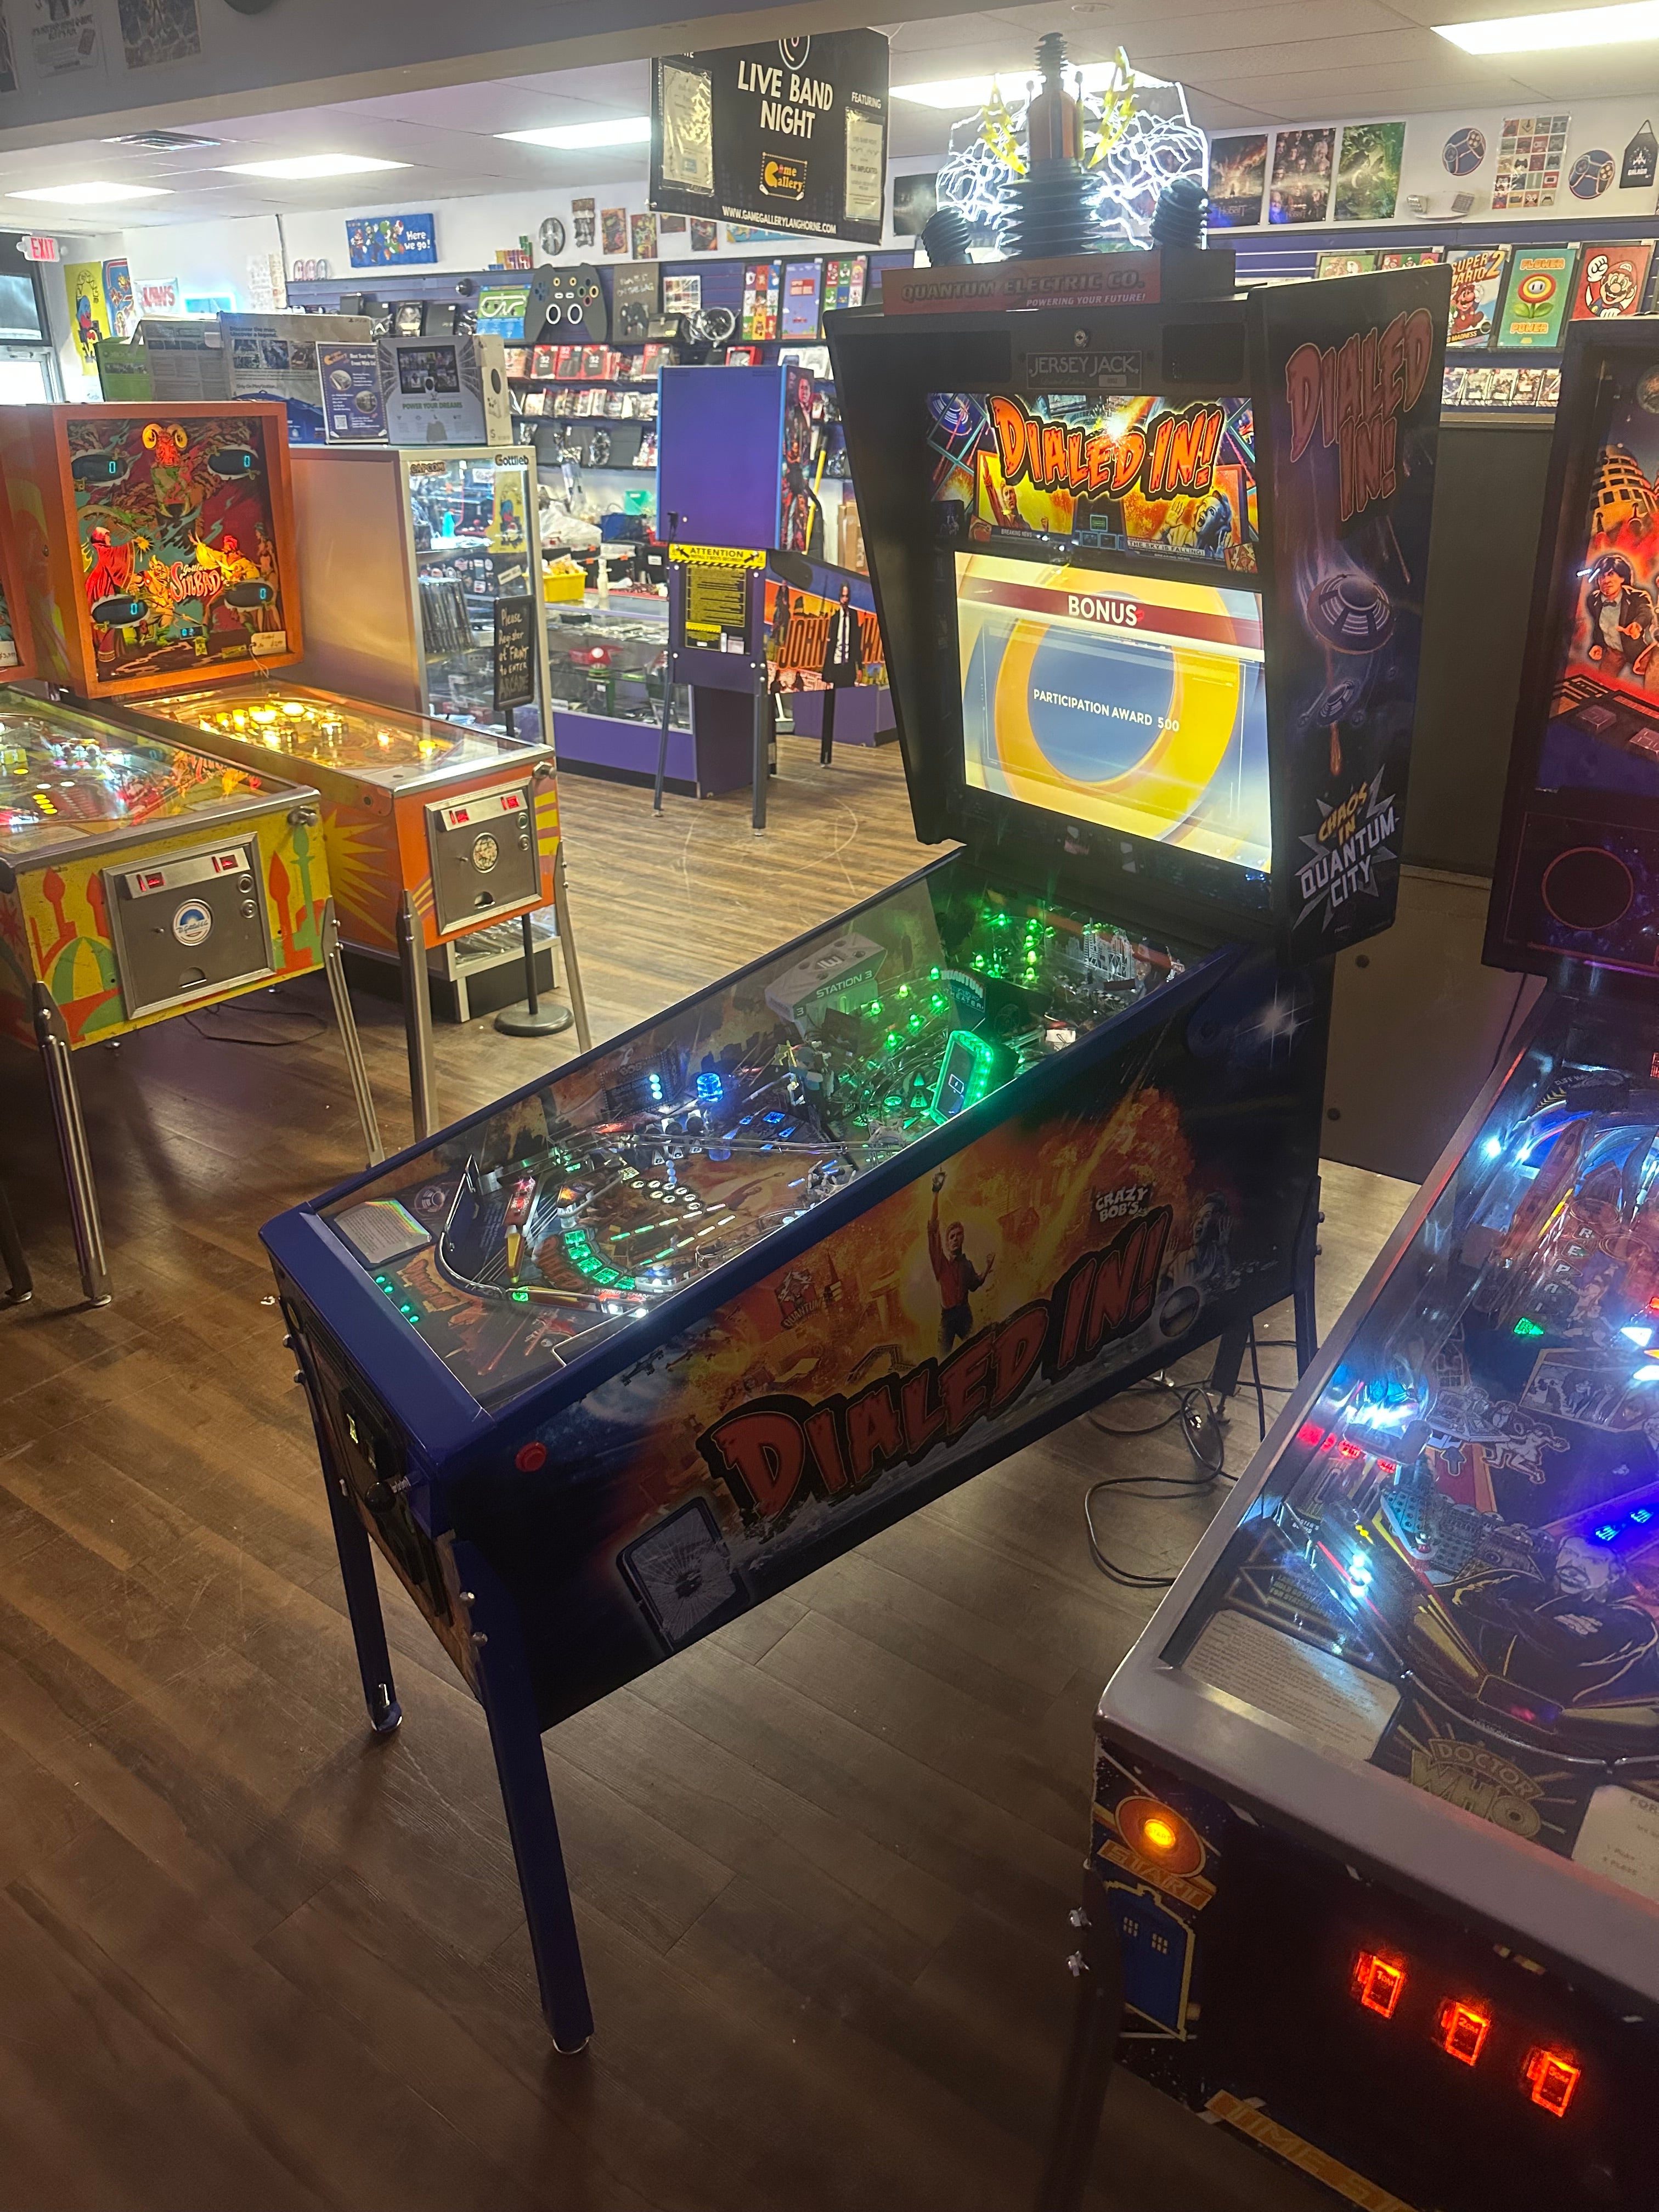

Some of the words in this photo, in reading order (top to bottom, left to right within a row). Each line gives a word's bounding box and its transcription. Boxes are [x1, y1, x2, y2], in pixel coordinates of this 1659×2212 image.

[737, 60, 783, 99] LIVE
[789, 73, 833, 111] BAND
[851, 91, 882, 109] FEATURING
[760, 100, 816, 139] NIGHT
[721, 205, 837, 235] WWW.GAMEGALLERYLANGHORNE.COM
[406, 230, 426, 240] Here
[416, 239, 431, 251] go!
[31, 238, 55, 259] EXIT
[1451, 252, 1489, 274] SUPER
[1486, 251, 1505, 277] 2
[1520, 258, 1565, 270] FLOWER
[142, 286, 176, 307] JAWS
[901, 282, 995, 302] QUANTUM
[1002, 272, 1100, 297] ELECTRIC
[1107, 270, 1145, 291] CO.
[1026, 296, 1074, 307] POWERING
[1077, 295, 1102, 305] YOUR
[1104, 293, 1146, 303] FUTURE!
[1451, 330, 1477, 342] MADNESS
[1510, 323, 1549, 334] POWER
[1029, 357, 1088, 379] JERSEY
[1089, 356, 1139, 377] JACK
[1285, 307, 1433, 462] DIALED
[990, 394, 1146, 492] DIALED
[1150, 409, 1222, 493] IN!
[410, 462, 445, 473] CAPCOM
[495, 454, 529, 466] Gottlieb
[1339, 413, 1397, 522] IN!
[690, 548, 744, 557] ATTENTION
[1171, 546, 1204, 556] FALLING!
[500, 607, 522, 628] Please
[1068, 595, 1138, 627] BONUS
[498, 629, 524, 648] Register
[777, 616, 830, 669] JOHN
[499, 648, 507, 662] at
[500, 664, 507, 676] to
[509, 662, 527, 674] ENTER
[499, 673, 529, 701] ARCADE
[1033, 689, 1110, 716] PARTICIPATION
[1112, 707, 1153, 726] AWARD
[1158, 716, 1180, 732] 500
[1318, 781, 1368, 842] CHAOS
[1338, 814, 1356, 846] IN
[1300, 805, 1395, 900] QUANTUM
[1330, 854, 1372, 907] CITY
[816, 975, 862, 998] STATION
[865, 970, 872, 979] 3
[797, 1007, 804, 1015] 3
[1096, 1186, 1148, 1211] CRAZY
[1099, 1201, 1139, 1222] BOB'S
[783, 1298, 823, 1327] QUANTUM
[711, 1305, 1049, 1520] DIALED
[1058, 1218, 1167, 1370] IN!
[1437, 1743, 1534, 1796] DOCTOR
[1410, 1749, 1541, 1838] WHO
[1149, 1826, 1171, 1842] START
[1105, 1844, 1198, 1901] START
